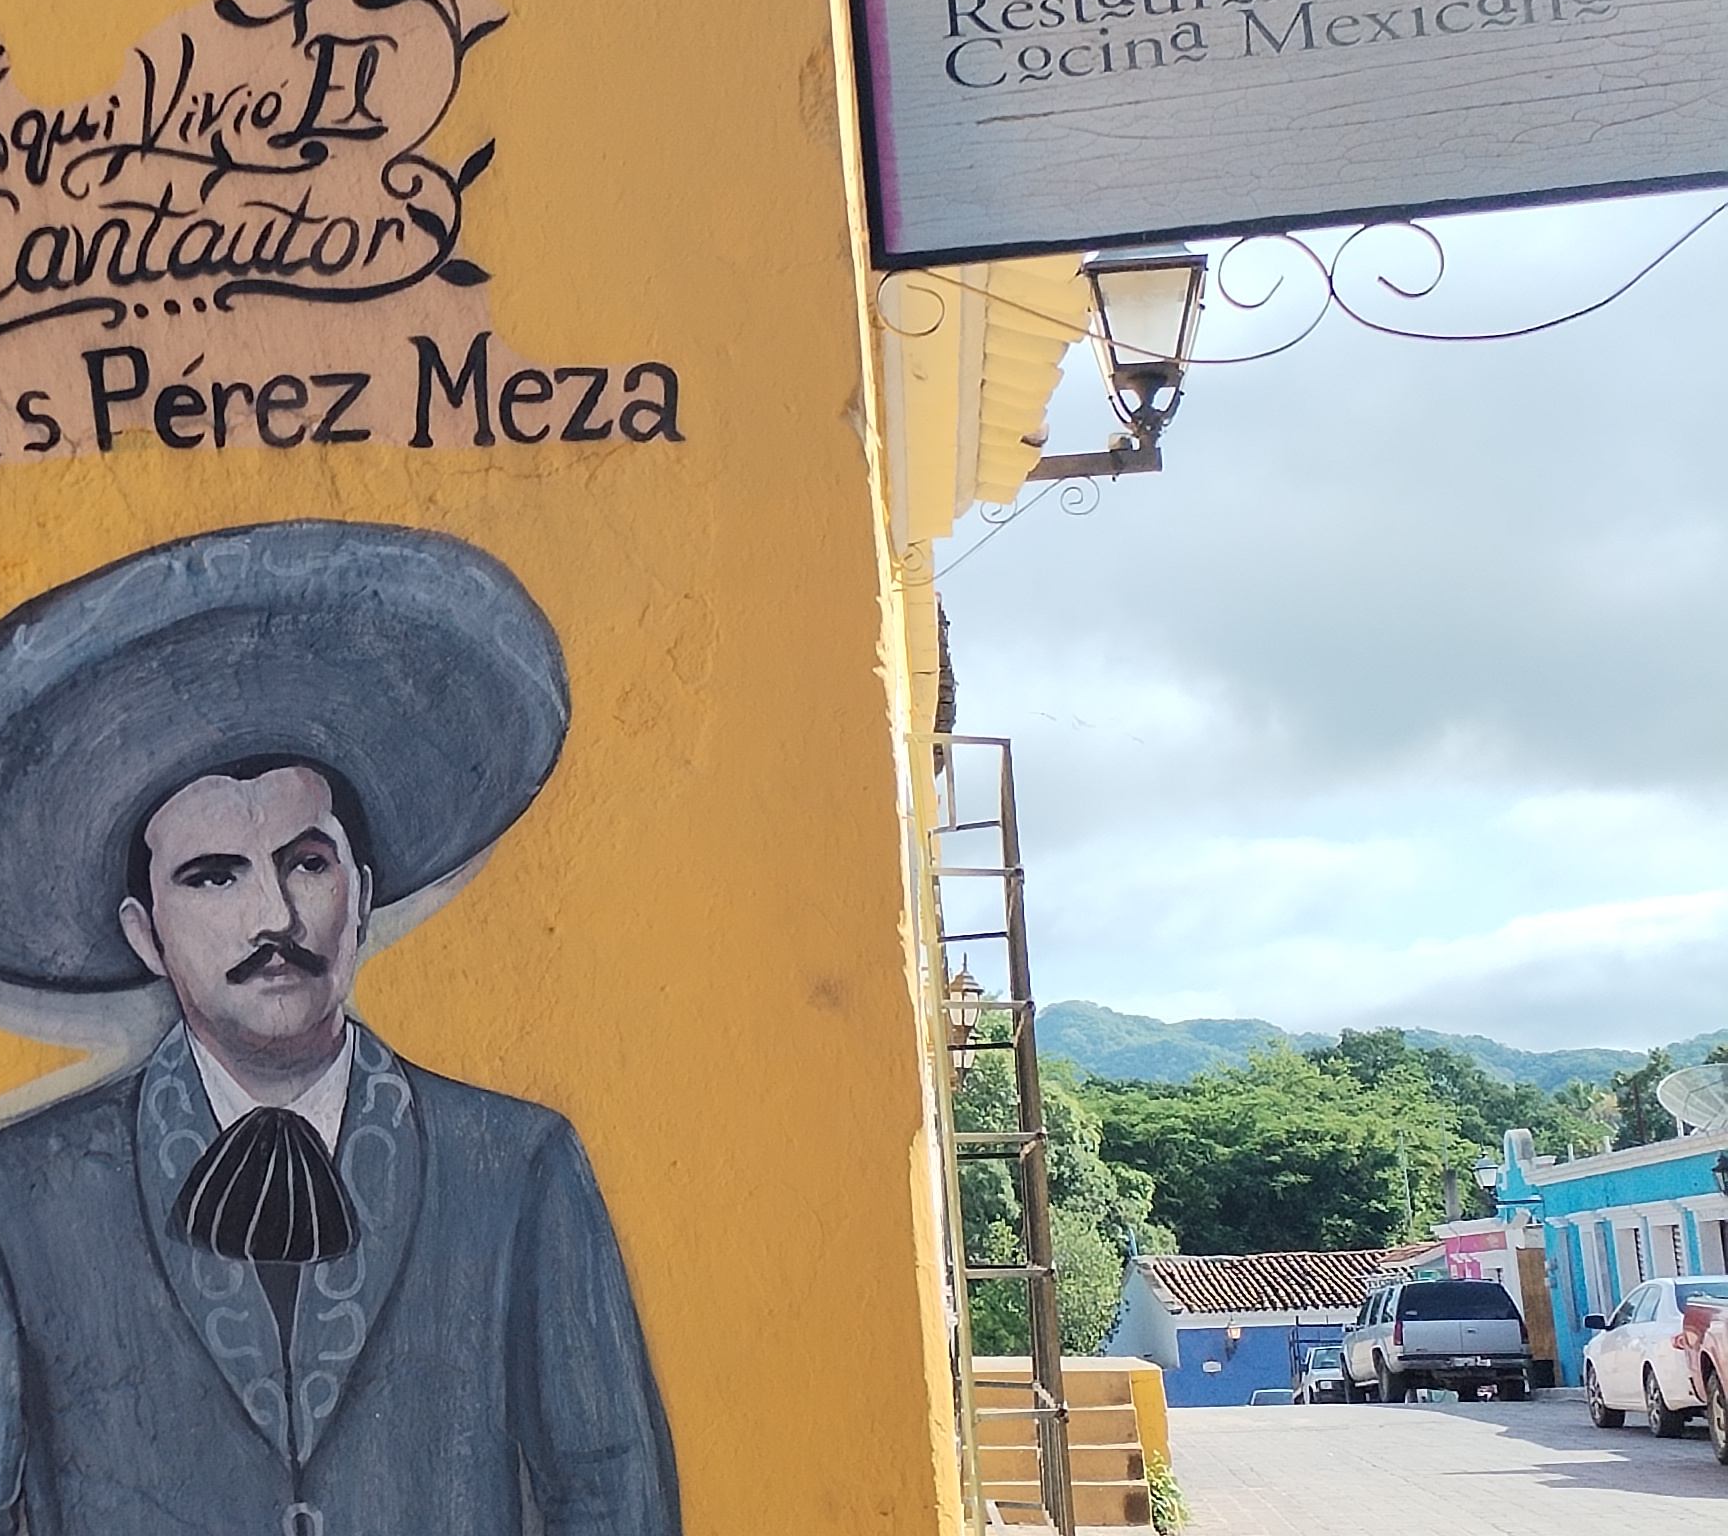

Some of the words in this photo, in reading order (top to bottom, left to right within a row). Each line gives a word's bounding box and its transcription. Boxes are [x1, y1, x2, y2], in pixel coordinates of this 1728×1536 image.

[267, 33, 400, 150] El
[946, 19, 1209, 89] Cocina
[82, 345, 372, 451] Pérez
[409, 331, 686, 449] Meza
